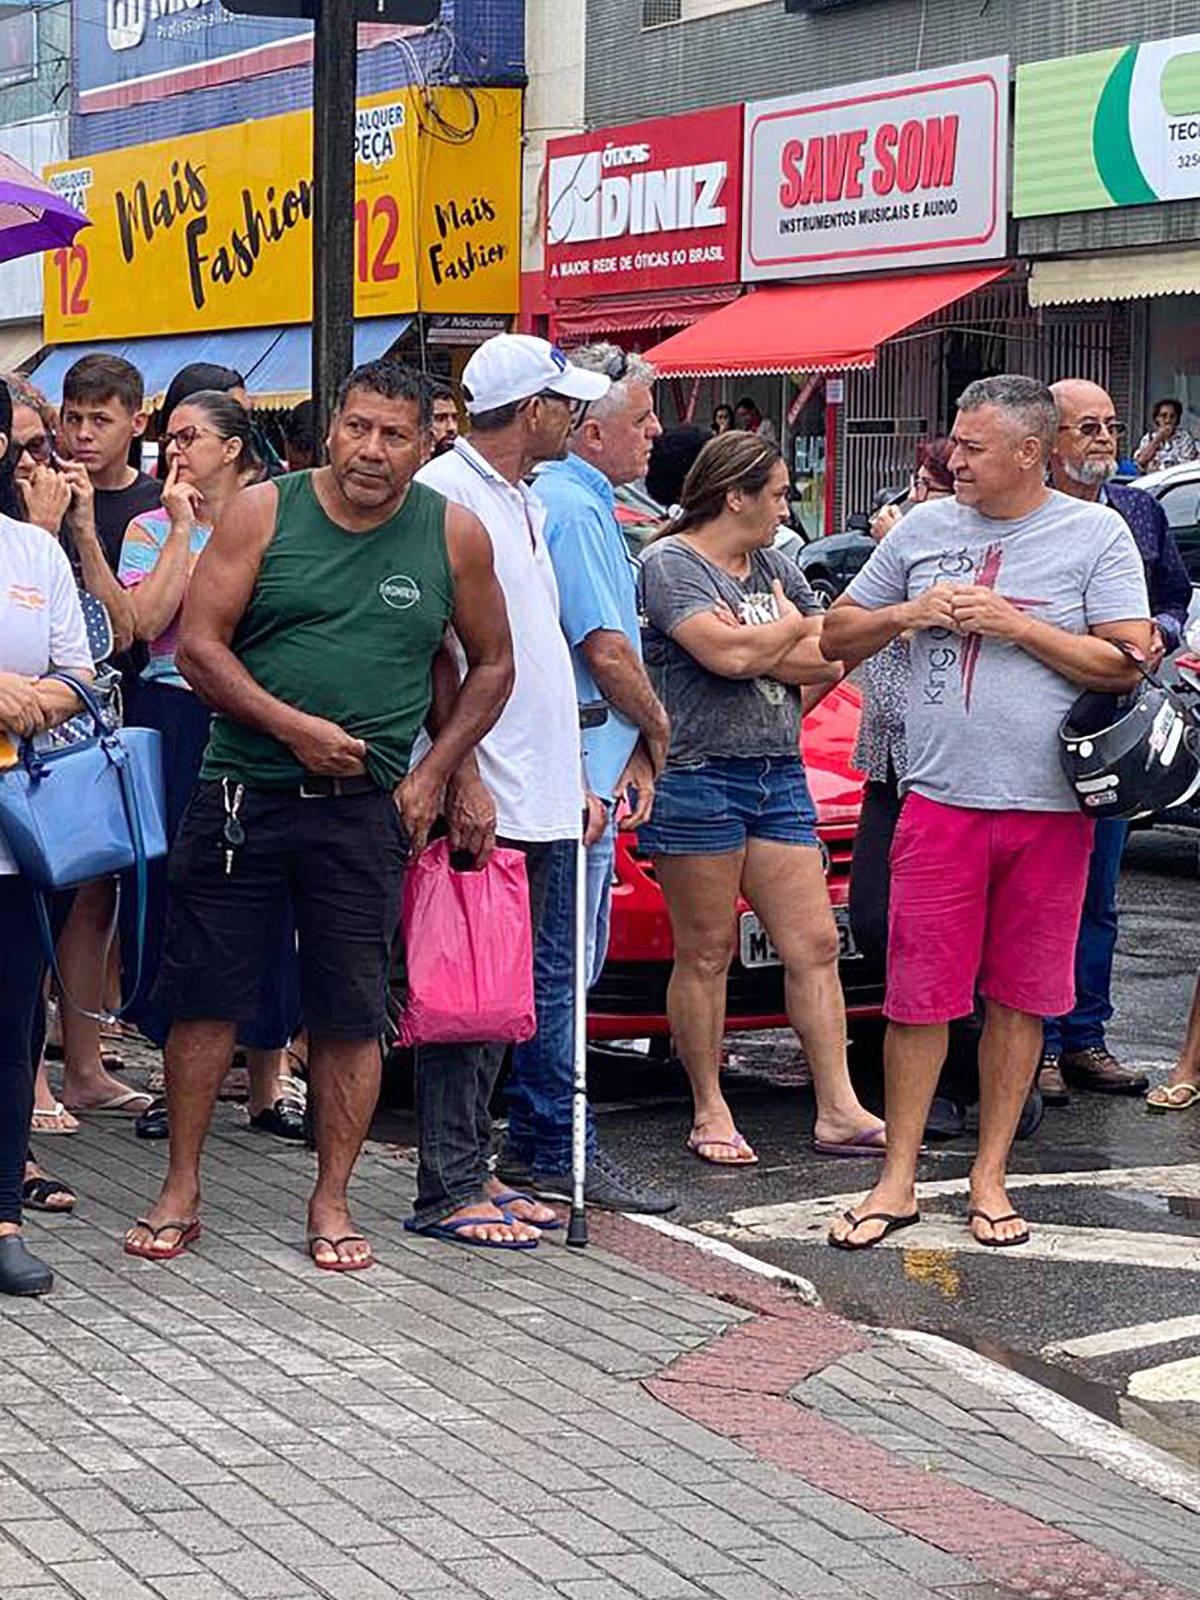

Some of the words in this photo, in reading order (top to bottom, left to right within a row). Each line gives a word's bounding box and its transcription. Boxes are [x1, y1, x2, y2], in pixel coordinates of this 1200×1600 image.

[357, 105, 405, 132] ALQUER
[1167, 121, 1200, 141] TEC
[603, 143, 650, 168] ÓTICAS
[779, 130, 868, 209] SAVE
[871, 115, 959, 196] SOM
[1177, 152, 1200, 169] 325
[115, 160, 207, 264] Mais
[434, 196, 495, 240] Mais
[600, 161, 728, 240] DINIZ
[779, 210, 856, 235] INSTRUMENTOS
[858, 203, 910, 226] MUSICAIS
[912, 202, 920, 219] E
[356, 194, 400, 282] 12
[54, 244, 91, 315] 12
[428, 241, 508, 286] Fashion
[550, 264, 558, 279] A
[560, 259, 590, 278] MAIOR
[592, 257, 618, 274] REDE
[620, 254, 633, 271] DE
[634, 249, 669, 269] ÓTICAS
[671, 249, 687, 266] DO
[688, 245, 725, 264] BRASIL
